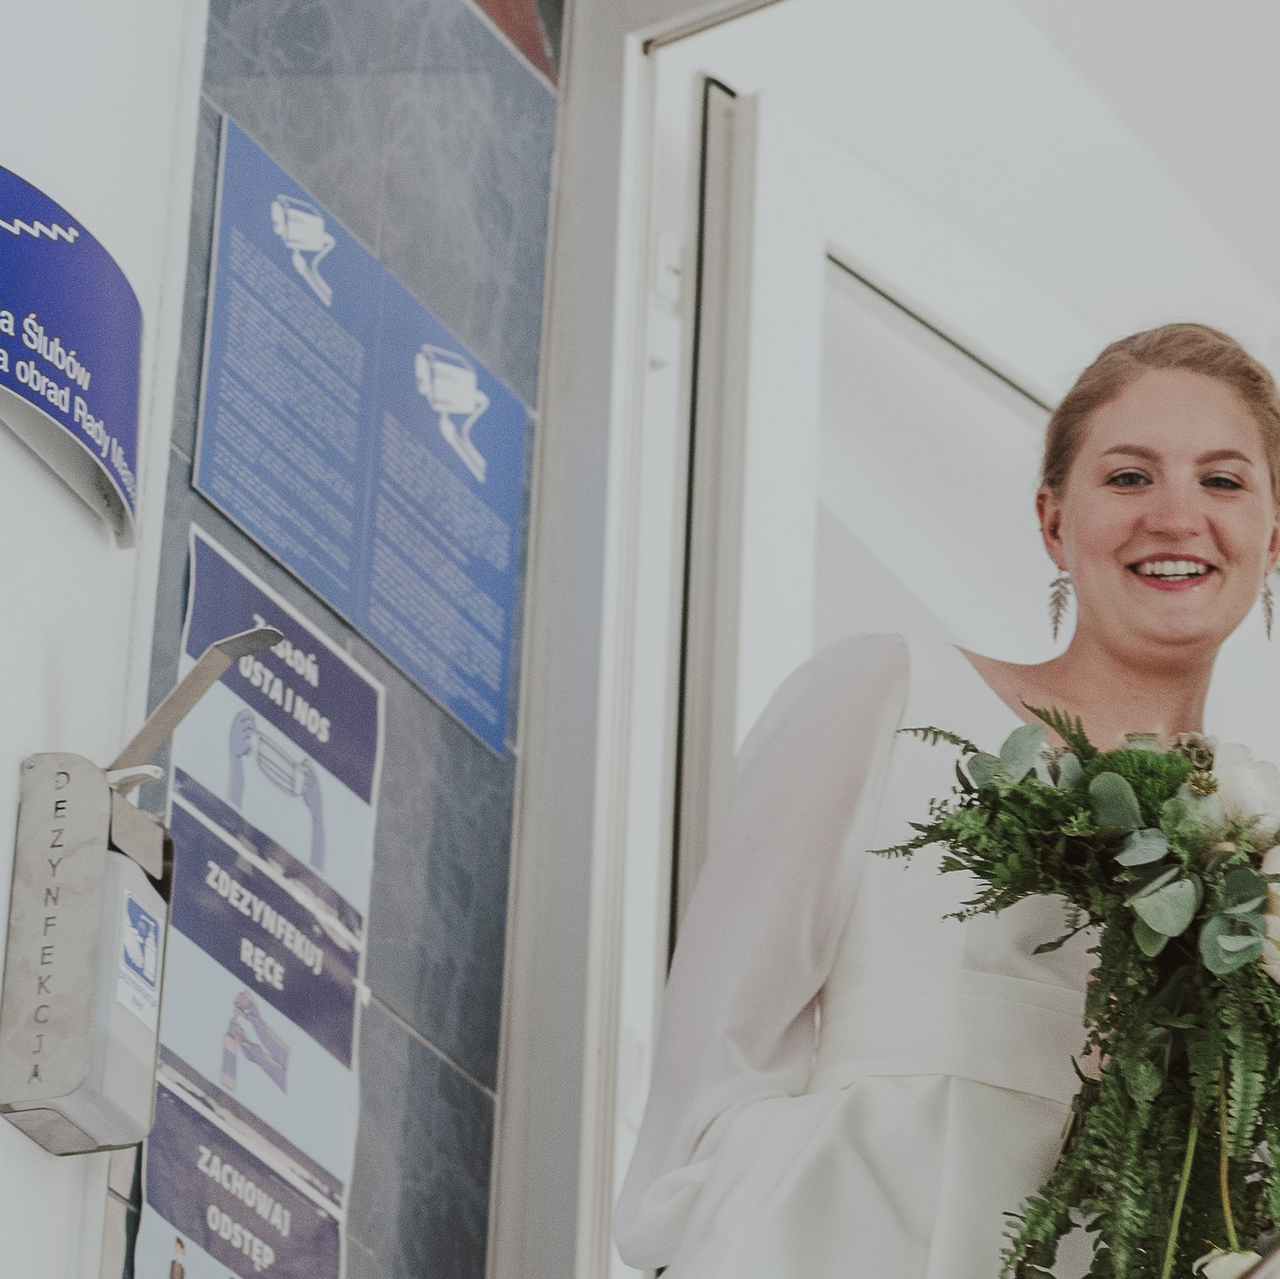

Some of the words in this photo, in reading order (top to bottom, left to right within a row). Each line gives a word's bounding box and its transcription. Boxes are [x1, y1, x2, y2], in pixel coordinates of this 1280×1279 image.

[22, 313, 91, 391] Ślubów
[15, 360, 70, 414] obrad
[74, 395, 110, 458] Rady
[239, 654, 283, 707] USTA
[284, 687, 294, 714] I
[293, 695, 331, 744] NOS
[27, 770, 71, 1084] DEZYNFEKCJA
[205, 860, 324, 976] ZDEZYNFEKUJ
[240, 937, 285, 991] RĘCE
[196, 1145, 292, 1238] ZACHOWAJ
[206, 1204, 277, 1272] ODSTĘP
